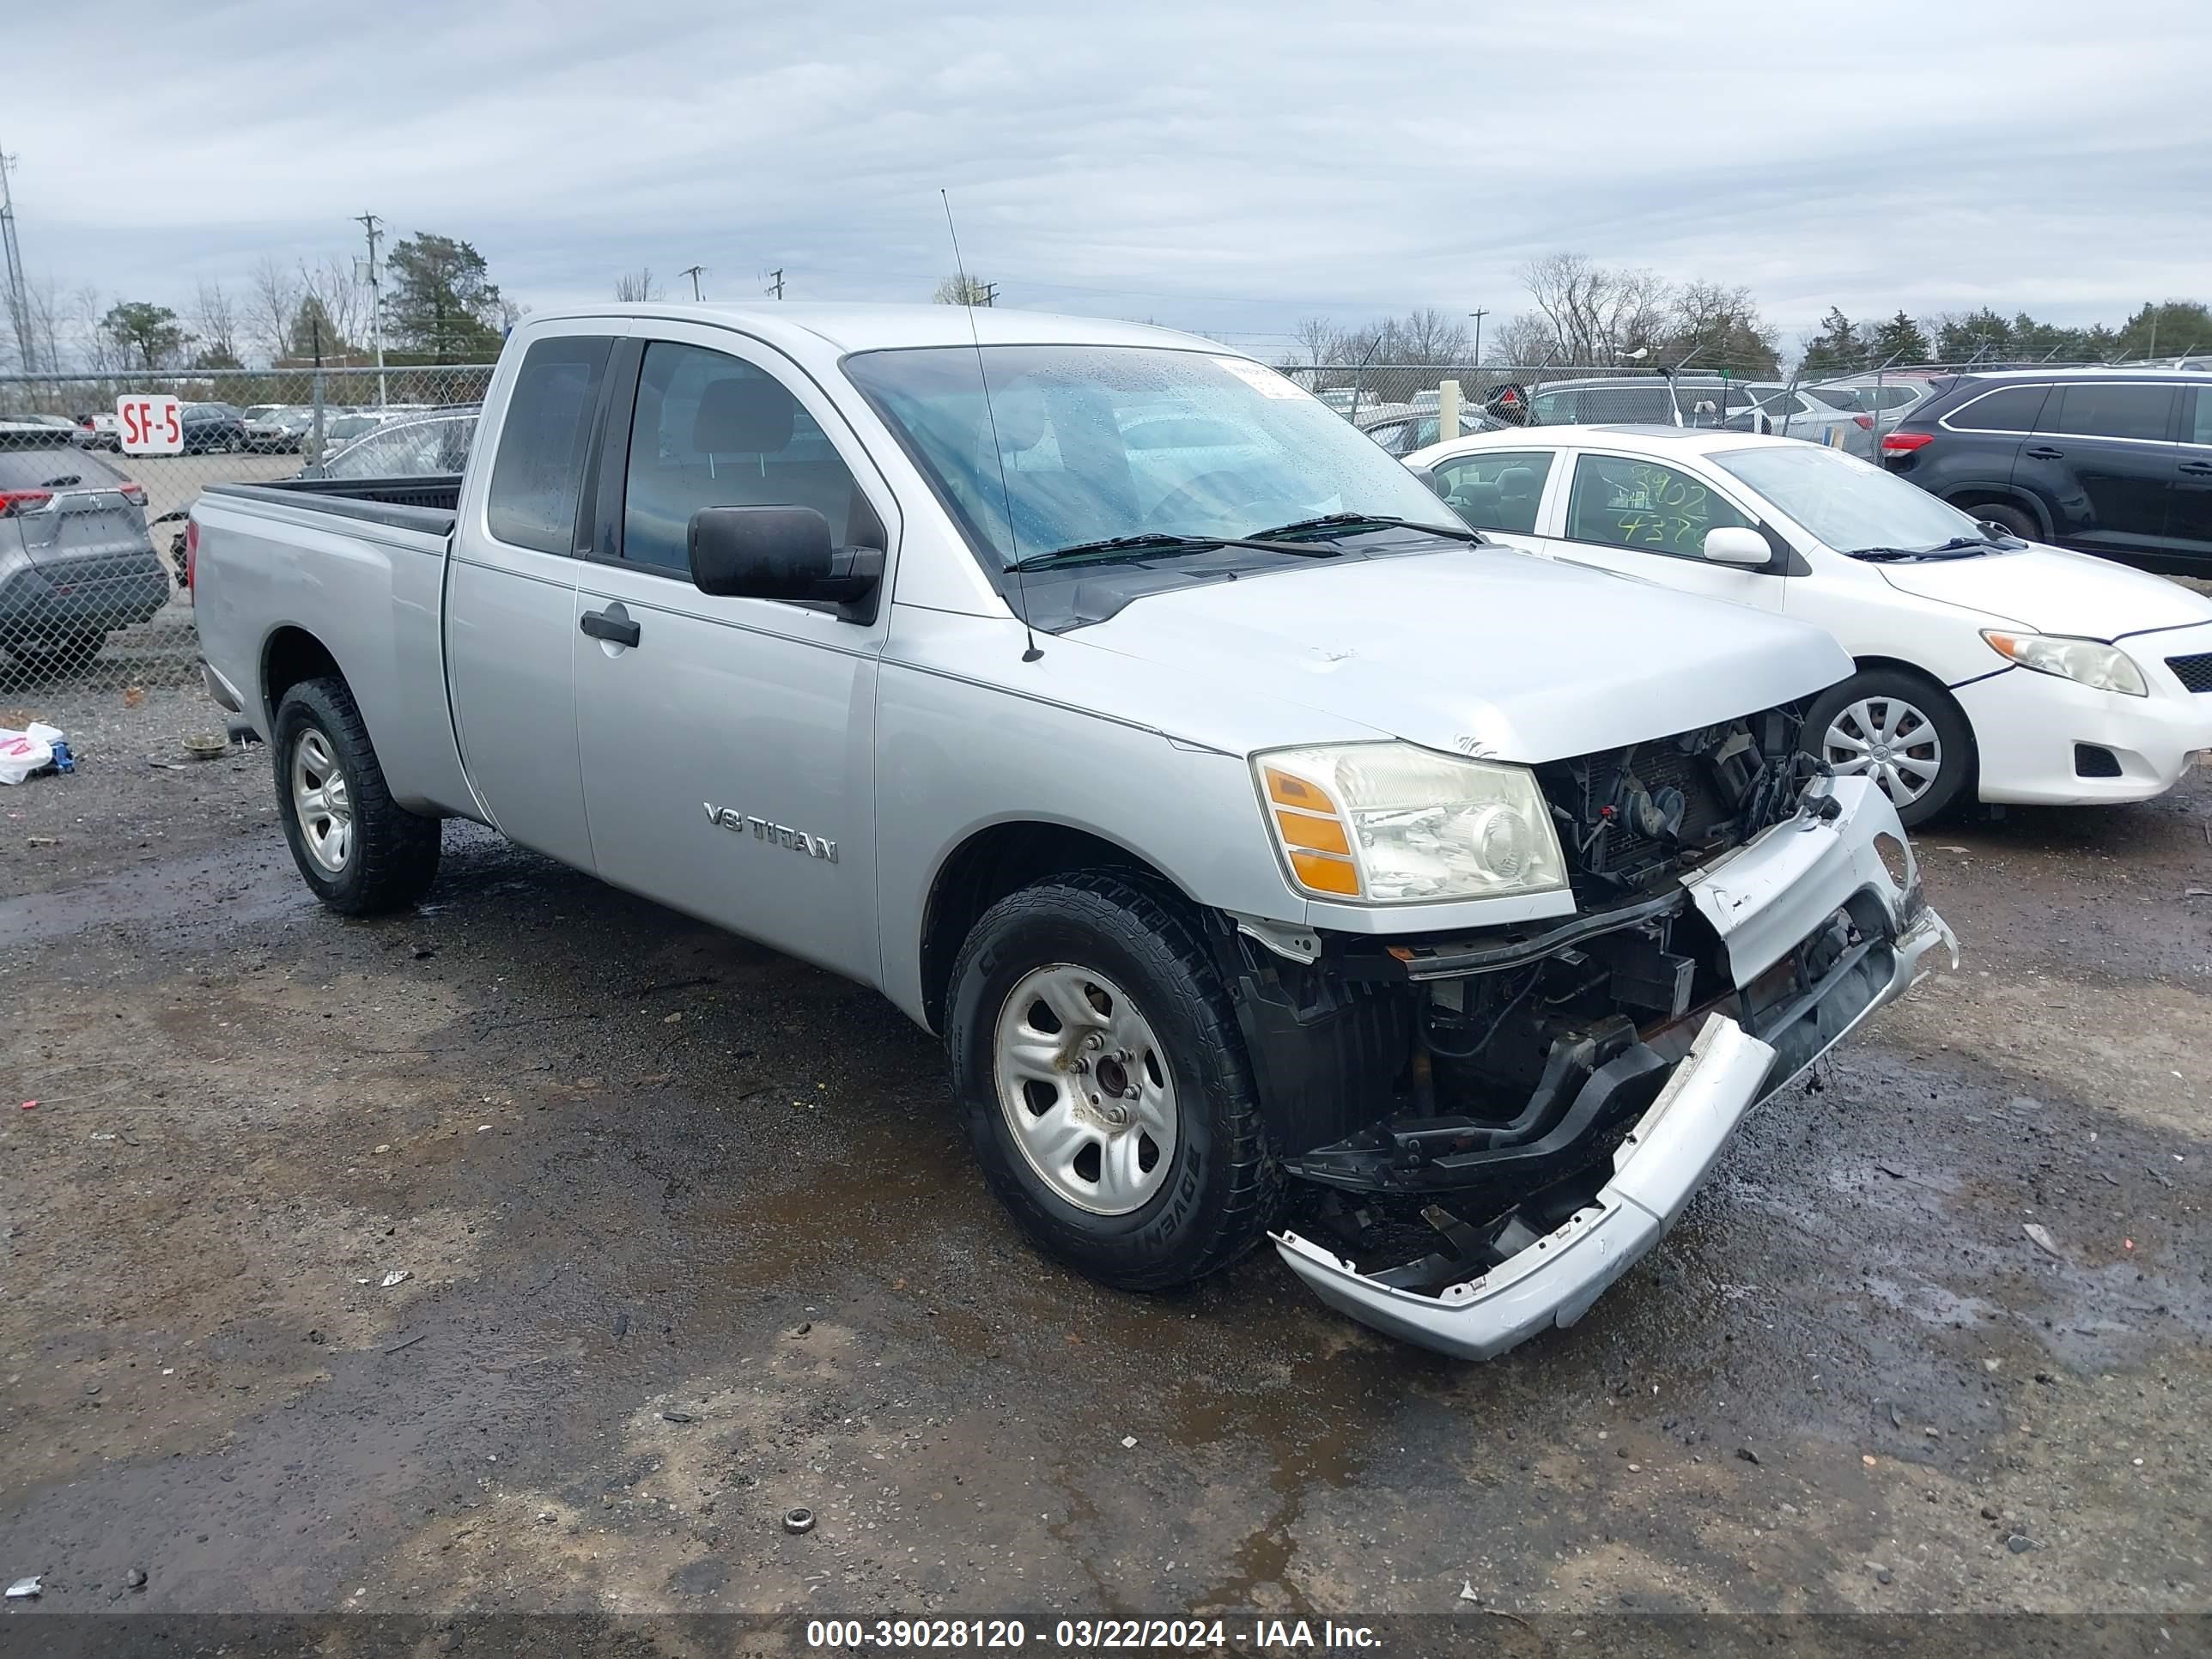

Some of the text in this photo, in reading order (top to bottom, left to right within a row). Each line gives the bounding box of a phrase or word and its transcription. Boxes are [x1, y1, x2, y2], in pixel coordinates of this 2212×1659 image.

[124, 404, 179, 444] SF-5
[702, 801, 839, 864] V8 TITAN
